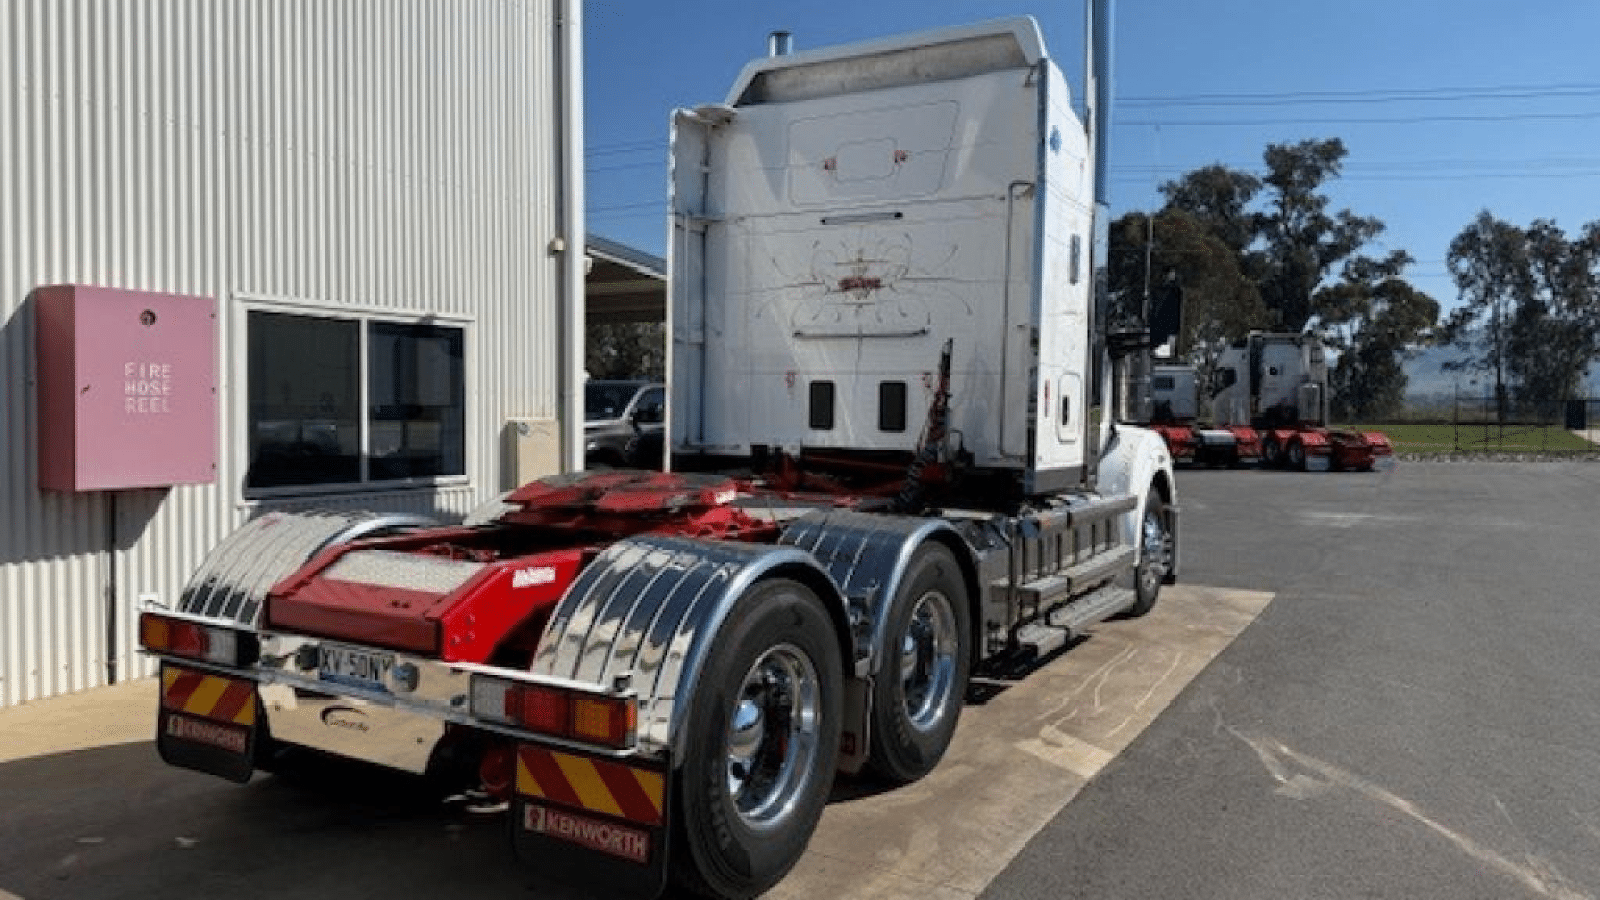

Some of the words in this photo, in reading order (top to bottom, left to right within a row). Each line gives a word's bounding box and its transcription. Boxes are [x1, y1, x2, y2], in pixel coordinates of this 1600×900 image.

[124, 361, 171, 379] FIRE
[124, 379, 171, 396] HOSE
[124, 396, 170, 413] REEL
[546, 809, 647, 861] KENWORTH
